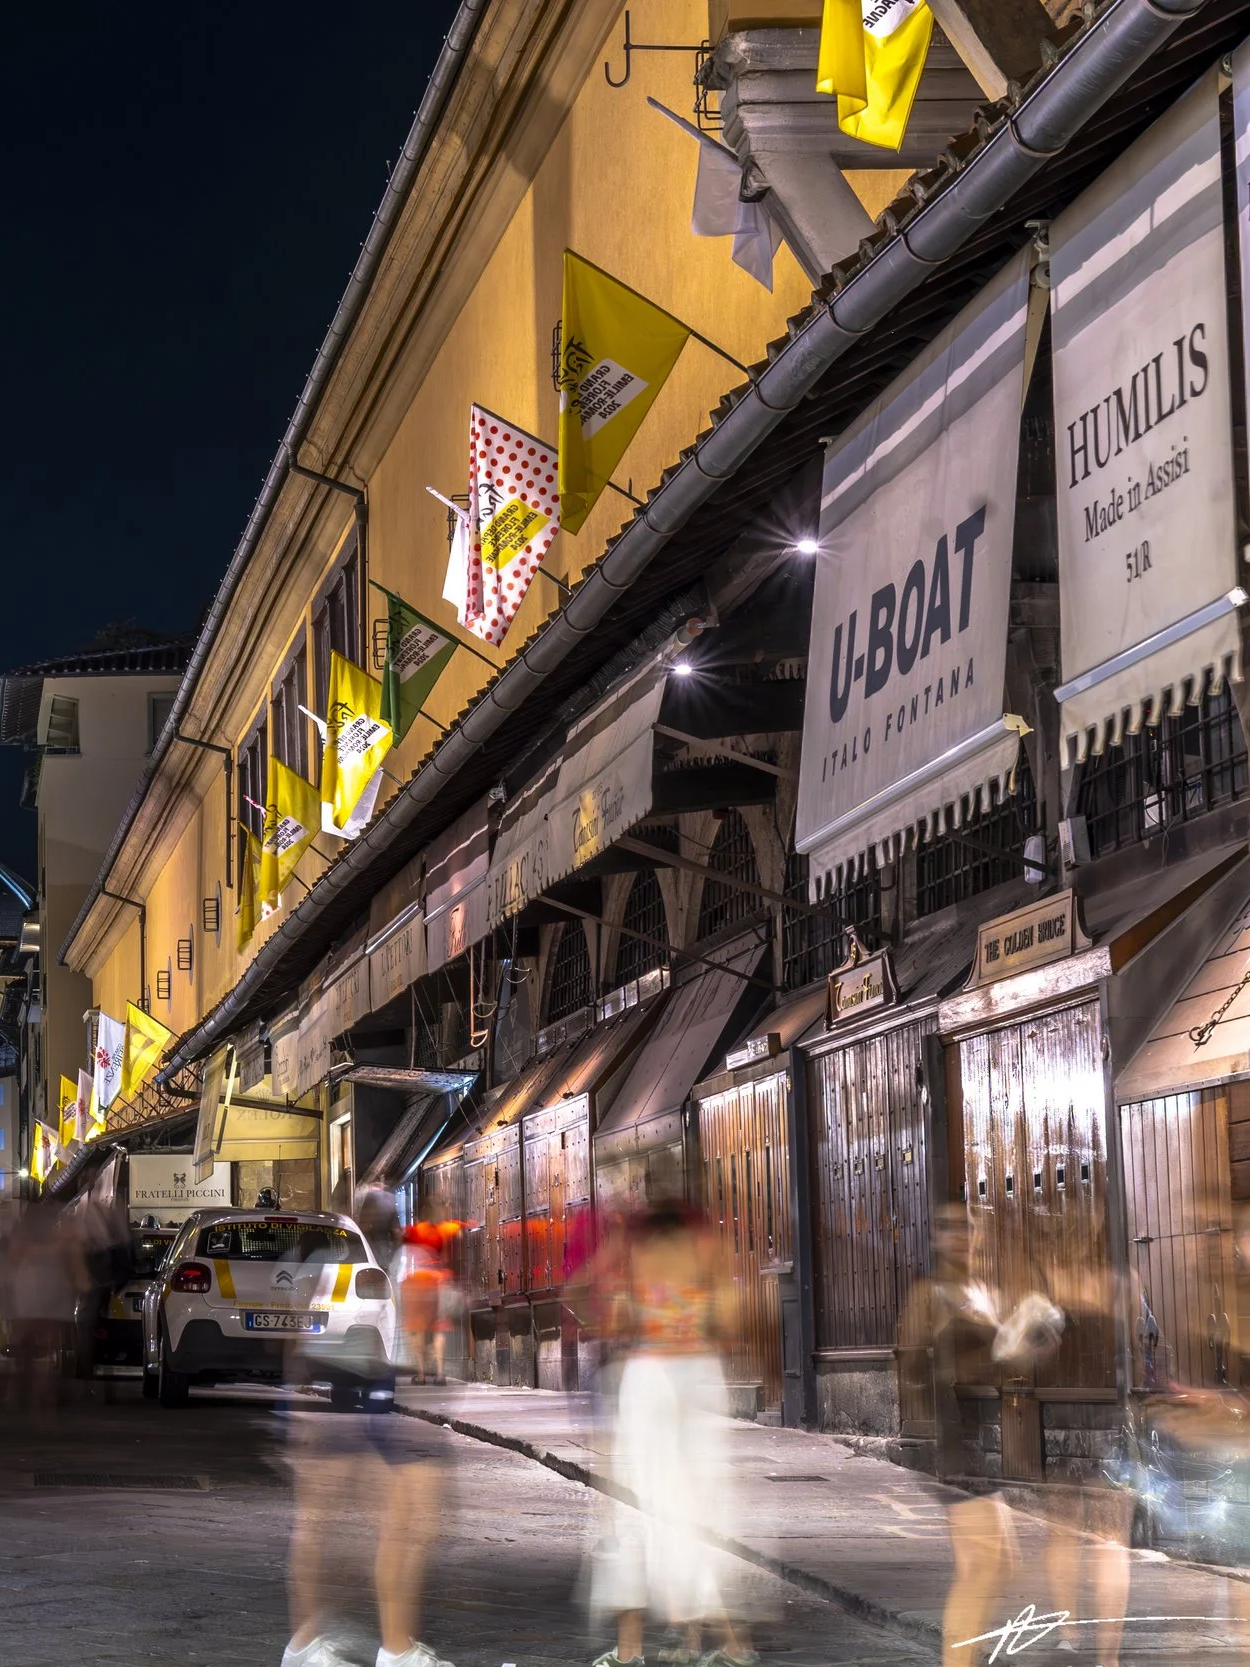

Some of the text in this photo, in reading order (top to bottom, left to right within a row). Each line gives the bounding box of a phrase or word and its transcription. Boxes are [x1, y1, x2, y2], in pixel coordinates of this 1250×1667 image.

[1067, 323, 1209, 489] HUMILIS
[1084, 435, 1190, 543] Made in Assisi
[829, 504, 986, 723] U-BOAT
[822, 657, 974, 783] ITALO FONTANA
[984, 913, 1065, 963] THE GOLDEN BRIDGE
[135, 1188, 225, 1199] FRATELLI PICCINI
[215, 1222, 268, 1232] ISTITUTO
[271, 1222, 283, 1230] DI
